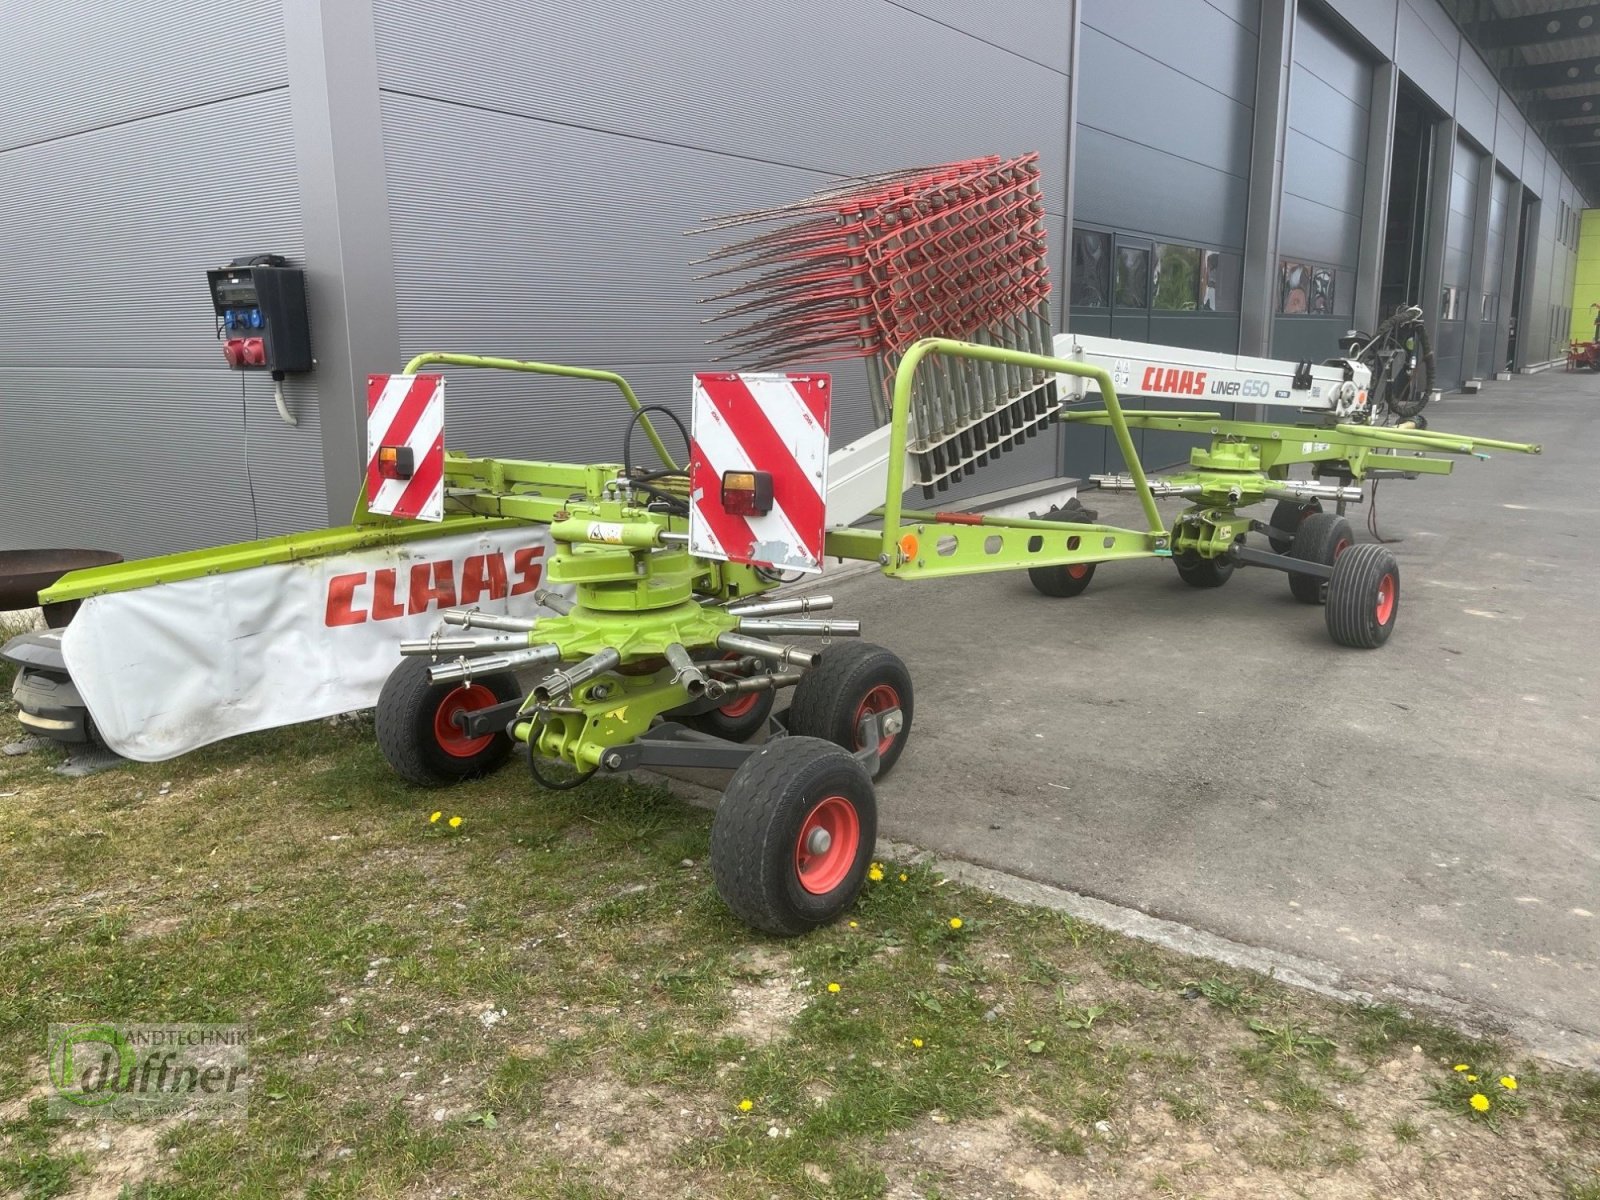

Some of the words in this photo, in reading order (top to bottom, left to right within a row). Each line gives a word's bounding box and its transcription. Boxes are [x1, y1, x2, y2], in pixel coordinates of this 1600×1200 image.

[1141, 367, 1207, 395] CLAAS
[1211, 381, 1241, 396] LINER
[1242, 379, 1270, 397] 650
[325, 546, 545, 628] CLAAS
